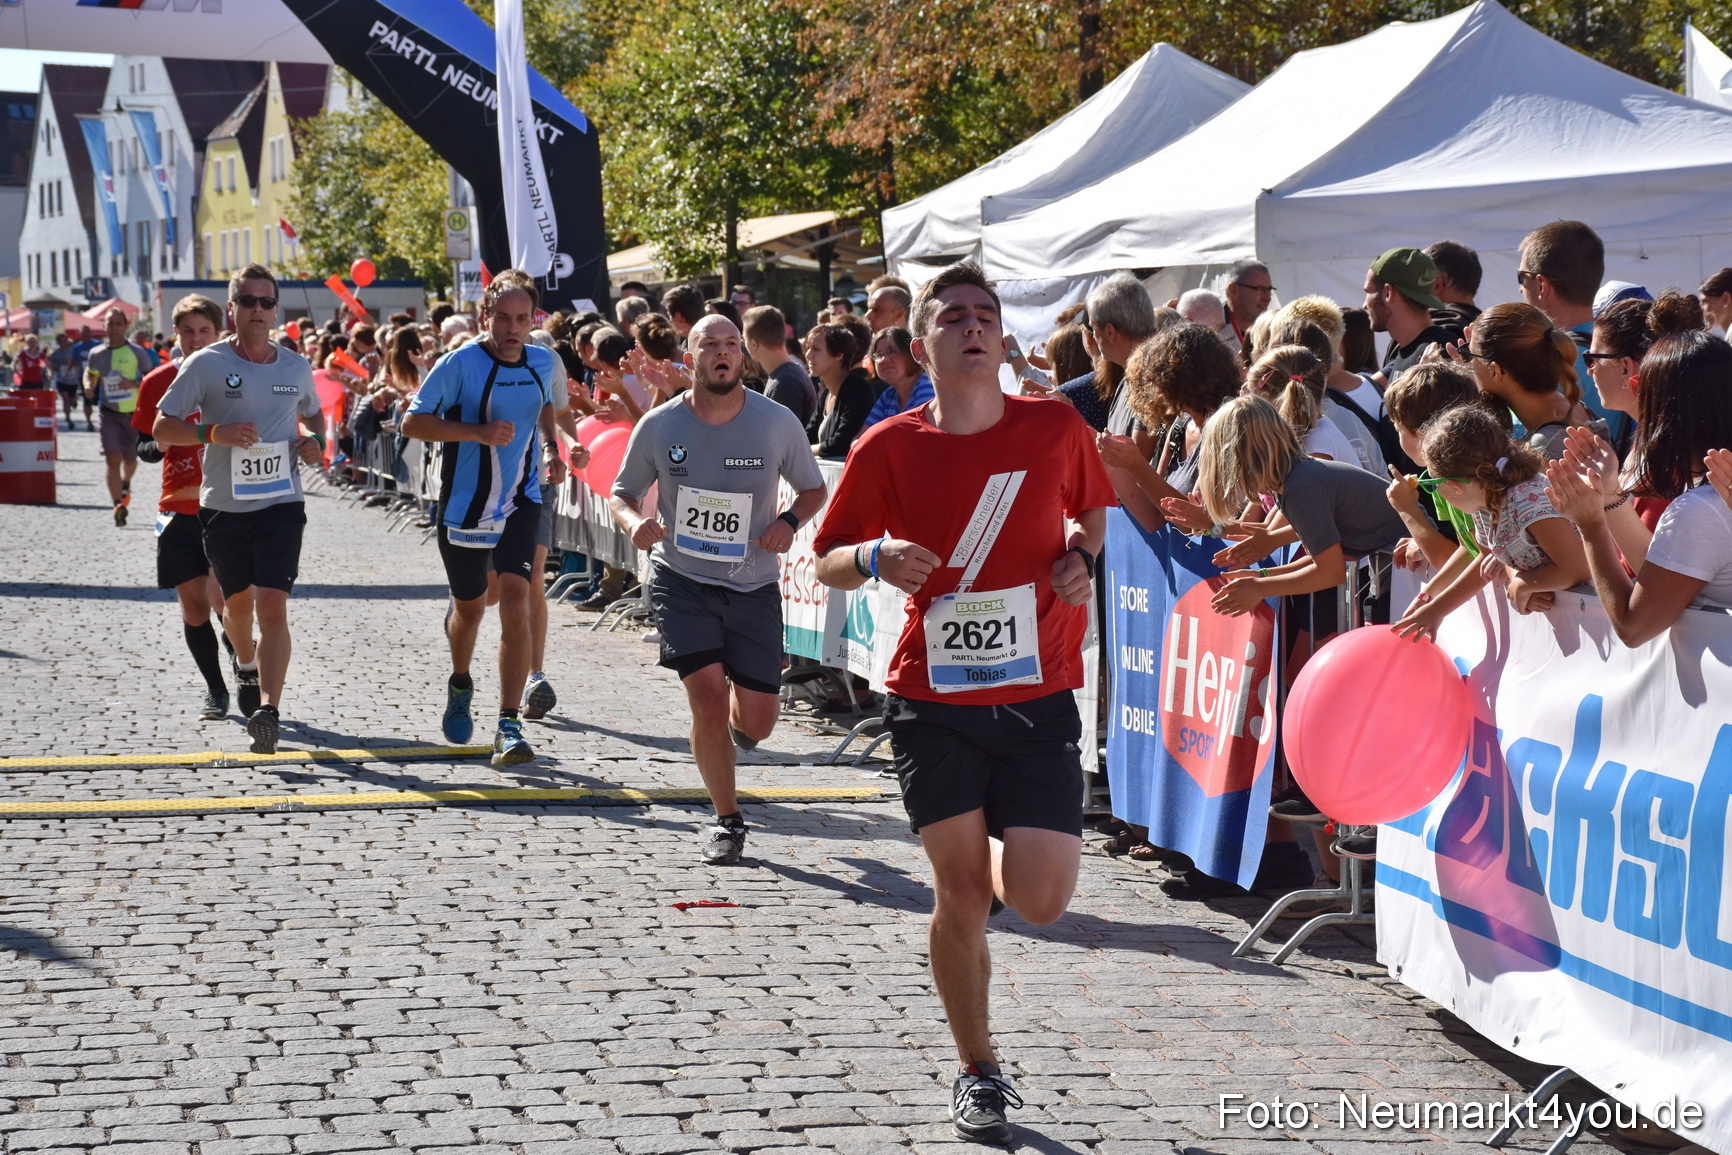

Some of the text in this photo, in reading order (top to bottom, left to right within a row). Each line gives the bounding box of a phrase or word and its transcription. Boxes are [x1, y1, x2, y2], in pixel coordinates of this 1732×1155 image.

[368, 20, 564, 146] PARTL NEUMKT
[516, 117, 544, 210] NEUMARKT
[272, 384, 299, 395] BOCK
[241, 455, 282, 476] 3107
[724, 457, 764, 467] BOCK
[698, 496, 732, 508] BOCK
[686, 507, 740, 533] 2186
[465, 533, 487, 542] Oliver
[689, 530, 727, 541] PARTL Neumarkt
[975, 533, 994, 564] Menschen
[991, 520, 1000, 533] und
[699, 542, 720, 555] Jörg
[1119, 585, 1149, 613] STORE
[955, 599, 1006, 613] BOCK
[942, 615, 1017, 650] 2621
[976, 653, 1008, 661] Neumarkt
[964, 668, 1006, 681] Tobias
